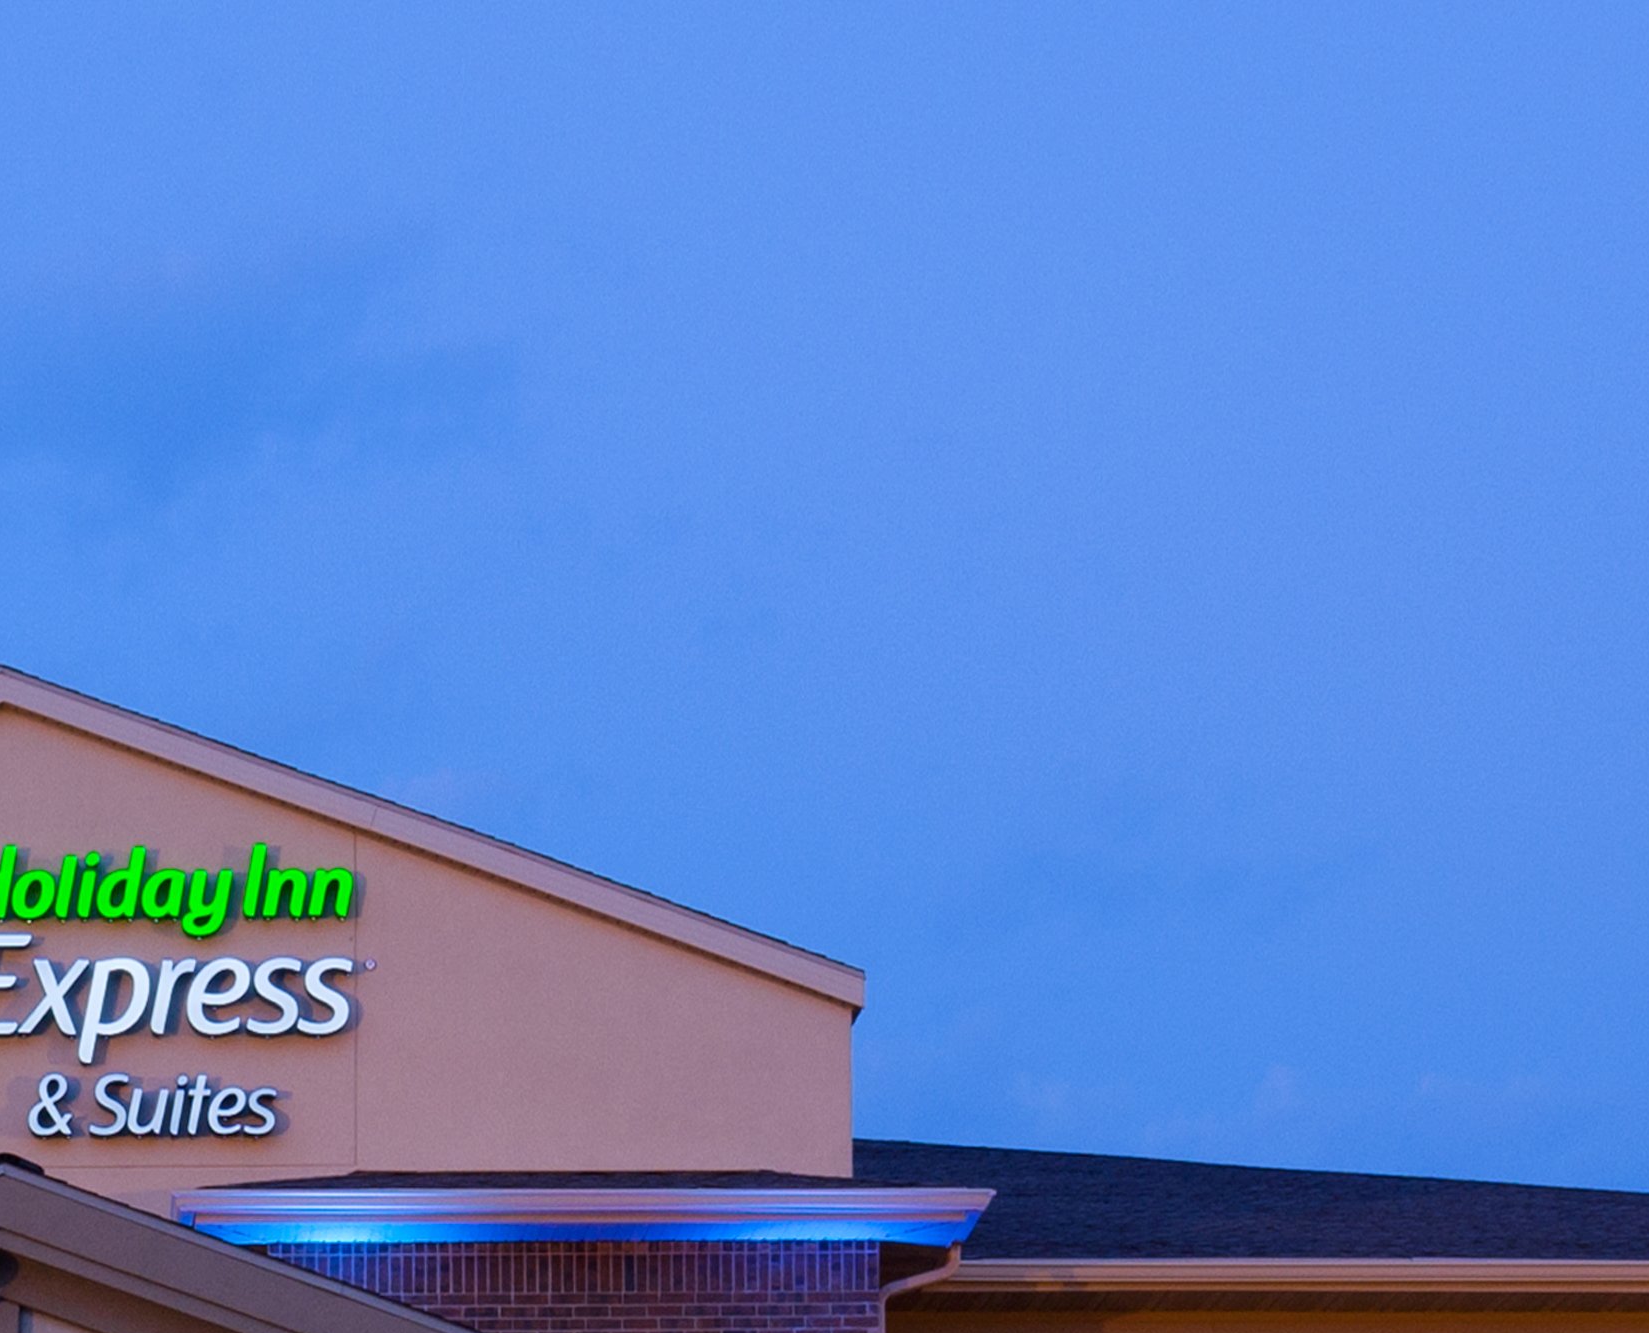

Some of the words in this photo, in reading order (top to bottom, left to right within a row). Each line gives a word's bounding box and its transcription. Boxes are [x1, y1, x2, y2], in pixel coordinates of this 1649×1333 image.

[241, 841, 355, 919] Inn
[28, 1072, 72, 1136] &
[88, 1073, 278, 1136] Suites
